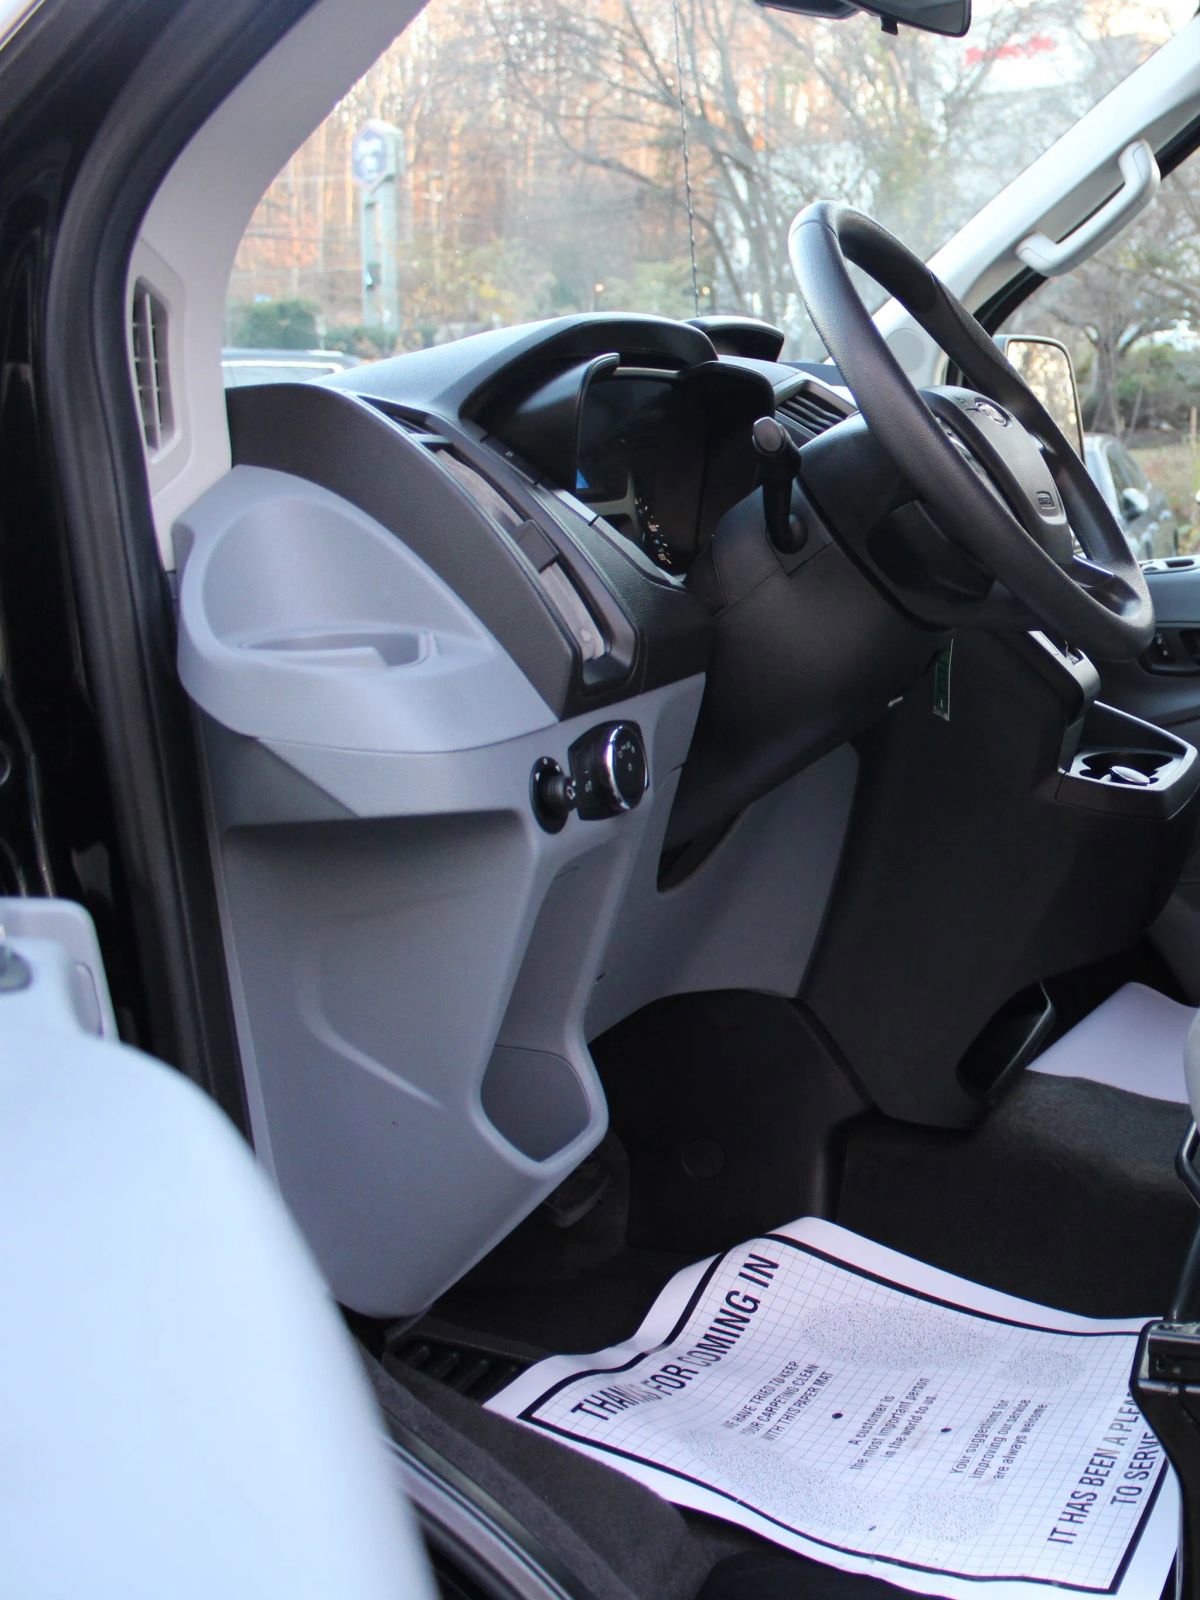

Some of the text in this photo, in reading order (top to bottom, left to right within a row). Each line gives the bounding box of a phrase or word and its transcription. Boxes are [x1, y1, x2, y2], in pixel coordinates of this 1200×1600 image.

[640, 1364, 699, 1396] FOR
[677, 1290, 761, 1367] COMING
[738, 1253, 780, 1288] IN
[731, 1405, 757, 1423] HAVE
[749, 1385, 776, 1405] TRIED
[768, 1377, 786, 1387] TO
[781, 1361, 800, 1379] KEEP
[757, 1386, 800, 1422] CARPETING
[792, 1364, 819, 1386] CLEAN
[776, 1407, 801, 1424] THIS
[794, 1387, 822, 1408] PAPER
[813, 1371, 834, 1387] MAT
[856, 1404, 888, 1438] customer
[849, 1378, 929, 1470] the most important person
[888, 1437, 906, 1449] the
[901, 1415, 922, 1436] world
[914, 1406, 928, 1414] to
[949, 1400, 1009, 1474] Your suggestions for
[968, 1400, 1031, 1478] improving our service
[993, 1466, 1010, 1479] are
[1002, 1435, 1027, 1464] always
[1047, 1391, 1141, 1544] IT HAS BEEN A PLEA
[1110, 1485, 1143, 1505] TO
